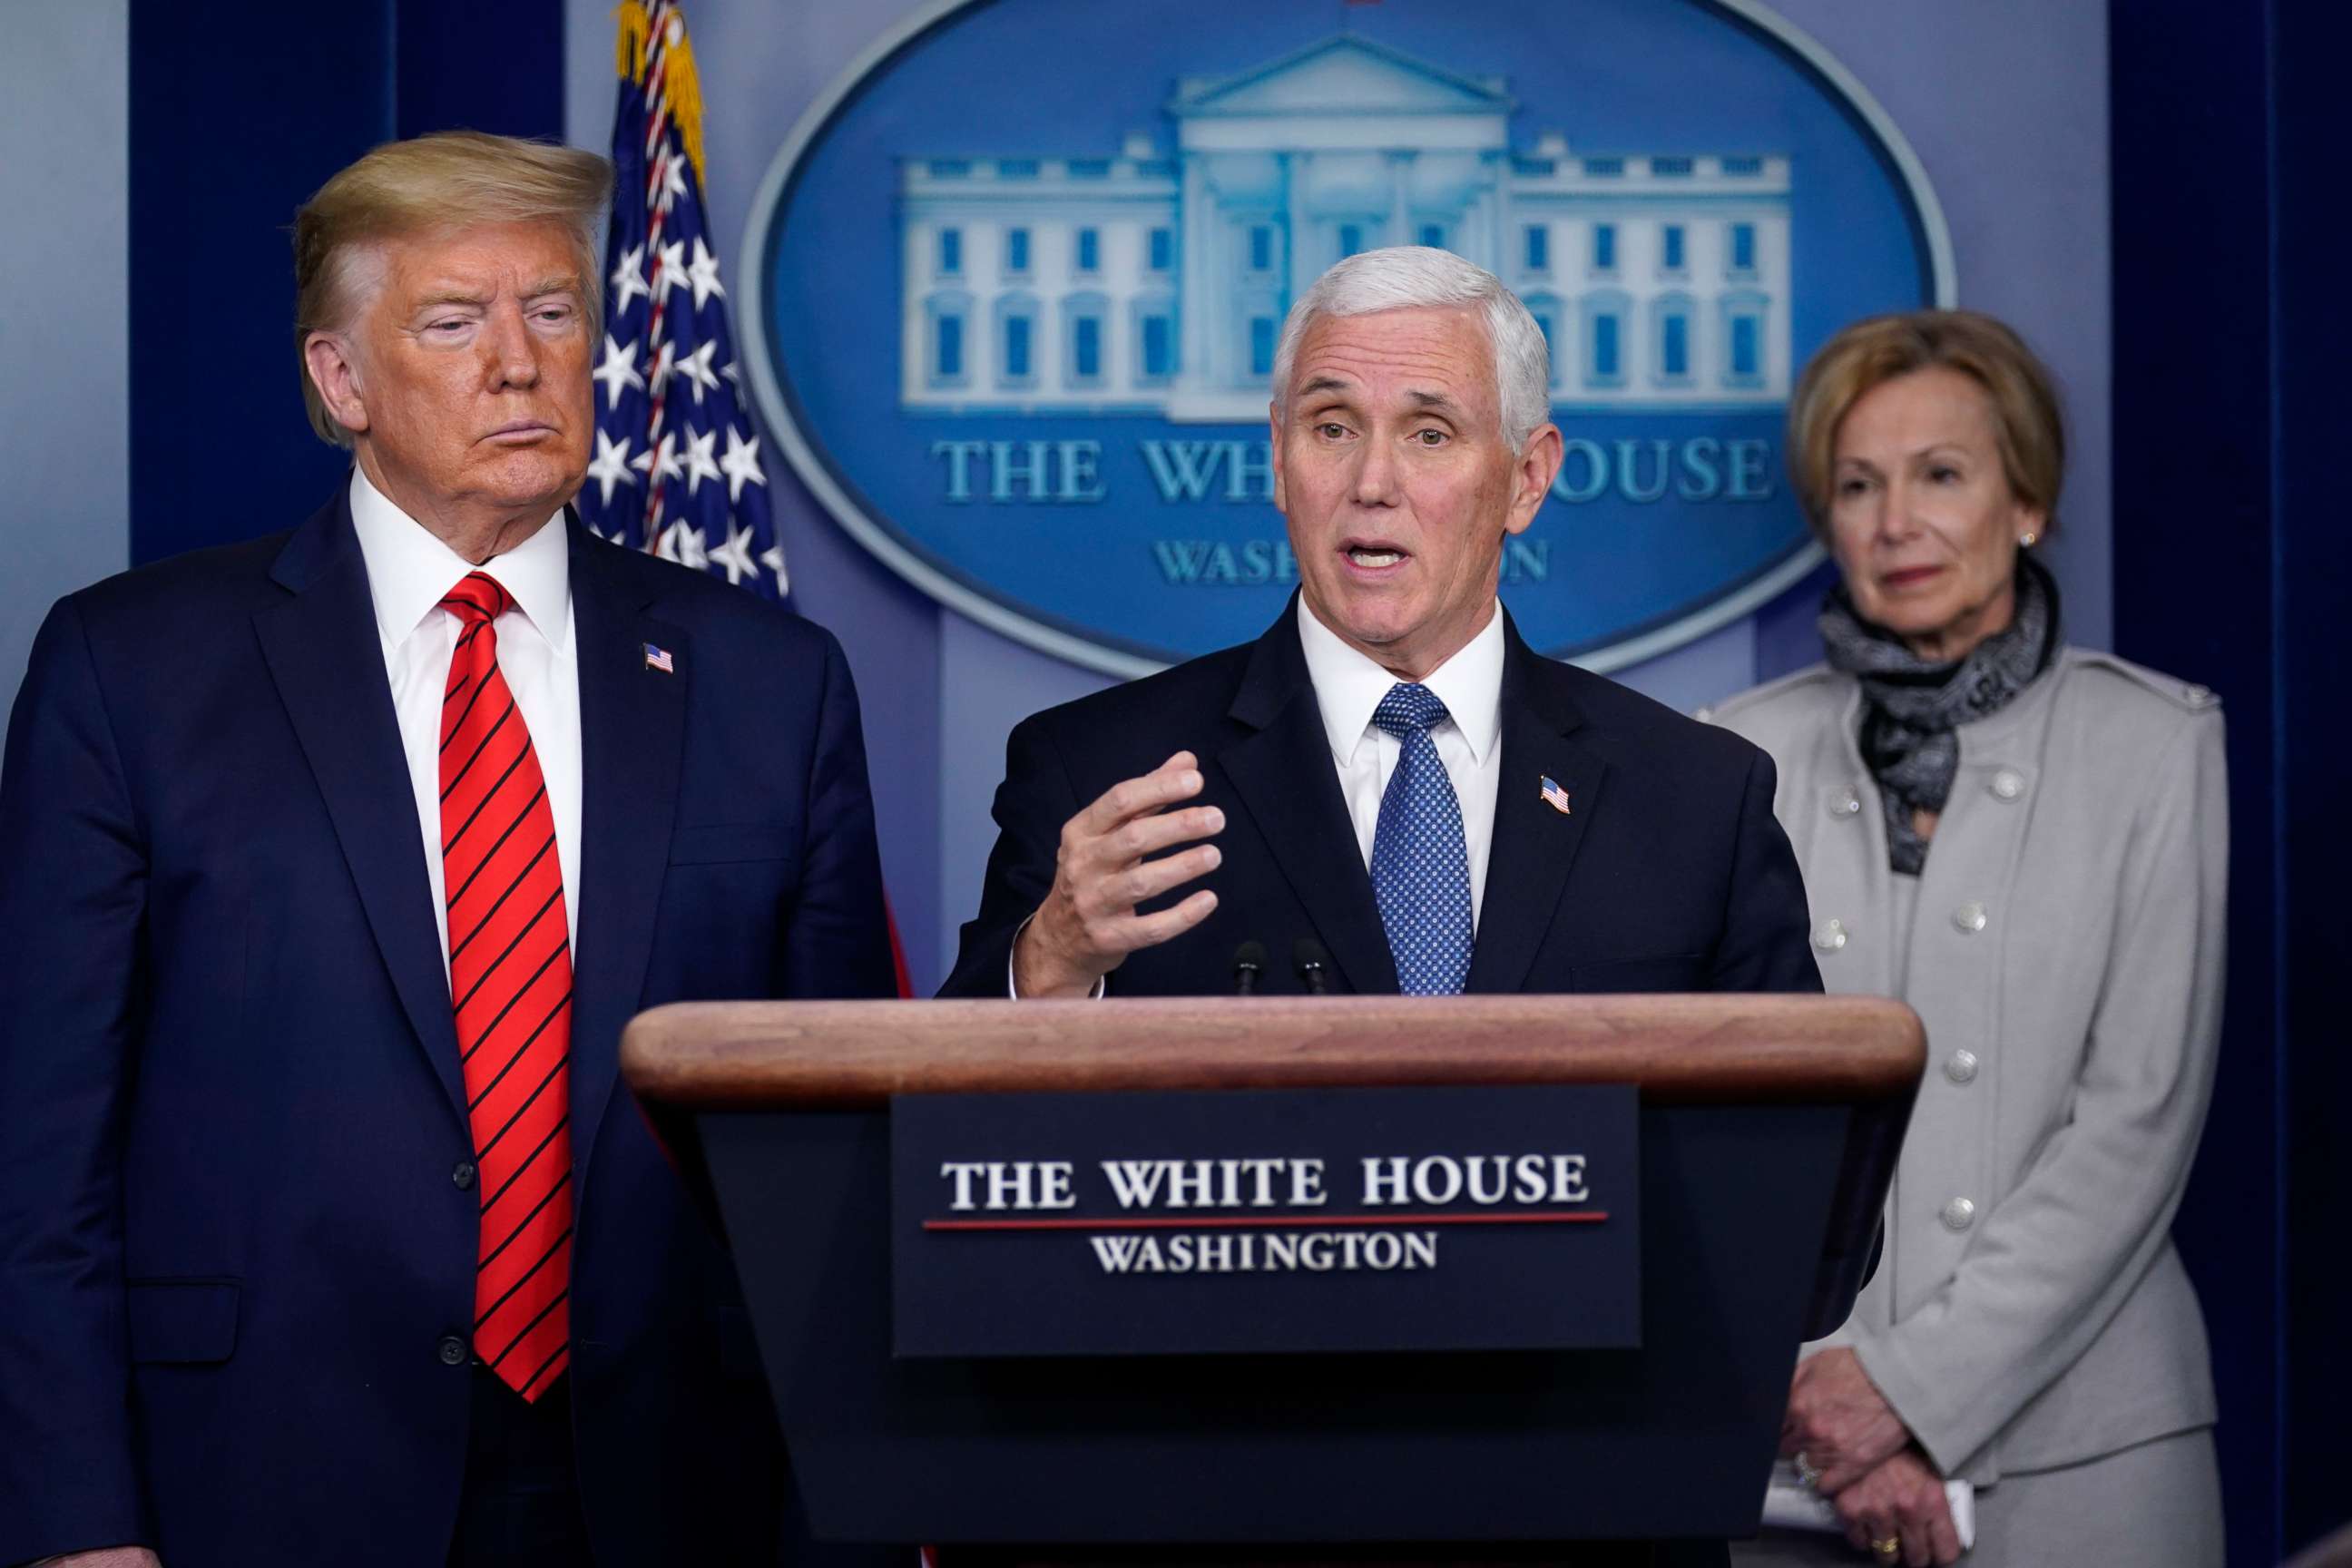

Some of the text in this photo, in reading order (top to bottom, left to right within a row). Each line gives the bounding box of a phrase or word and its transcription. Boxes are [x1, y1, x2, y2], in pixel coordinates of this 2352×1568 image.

[934, 440, 1105, 504] THE
[1553, 437, 1772, 502] OUSE
[941, 1154, 1589, 1210] THE WHITE HOUSE
[1090, 1231, 1437, 1272] WASHINGTON
